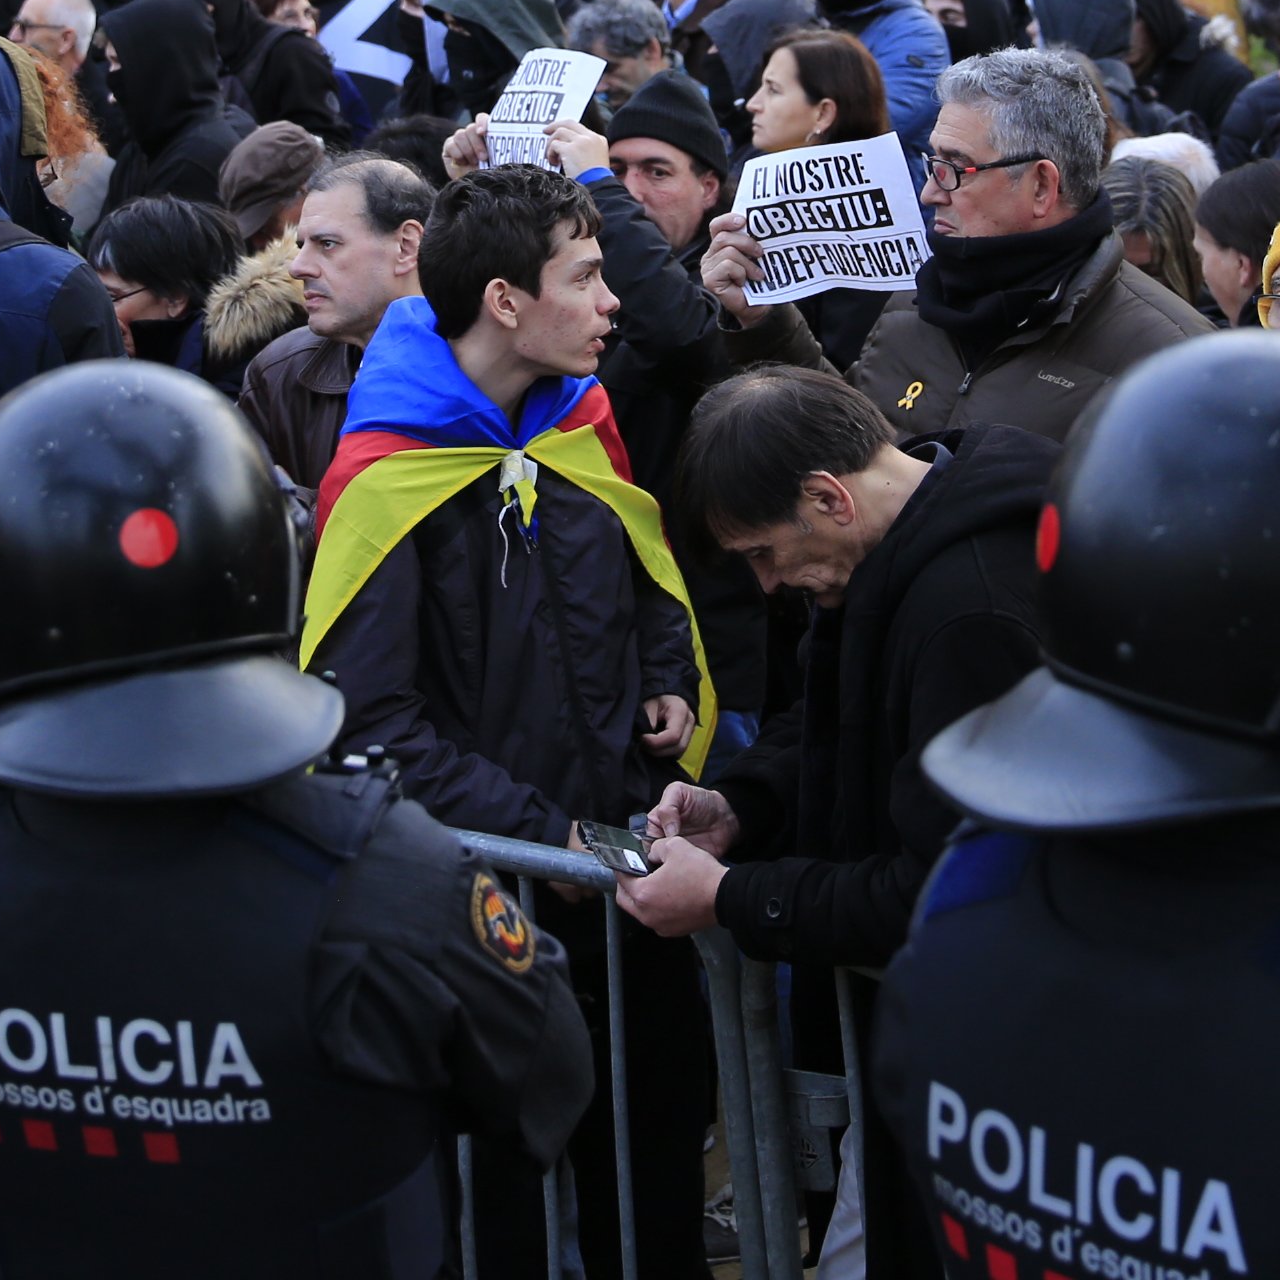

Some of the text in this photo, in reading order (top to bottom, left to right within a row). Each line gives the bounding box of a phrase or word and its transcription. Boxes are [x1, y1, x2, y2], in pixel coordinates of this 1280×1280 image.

[752, 152, 871, 200] EL NOSTRE
[748, 193, 888, 239] OBJECTIU:
[927, 1080, 1248, 1274] POLICIA
[932, 1172, 1043, 1252] mossos
